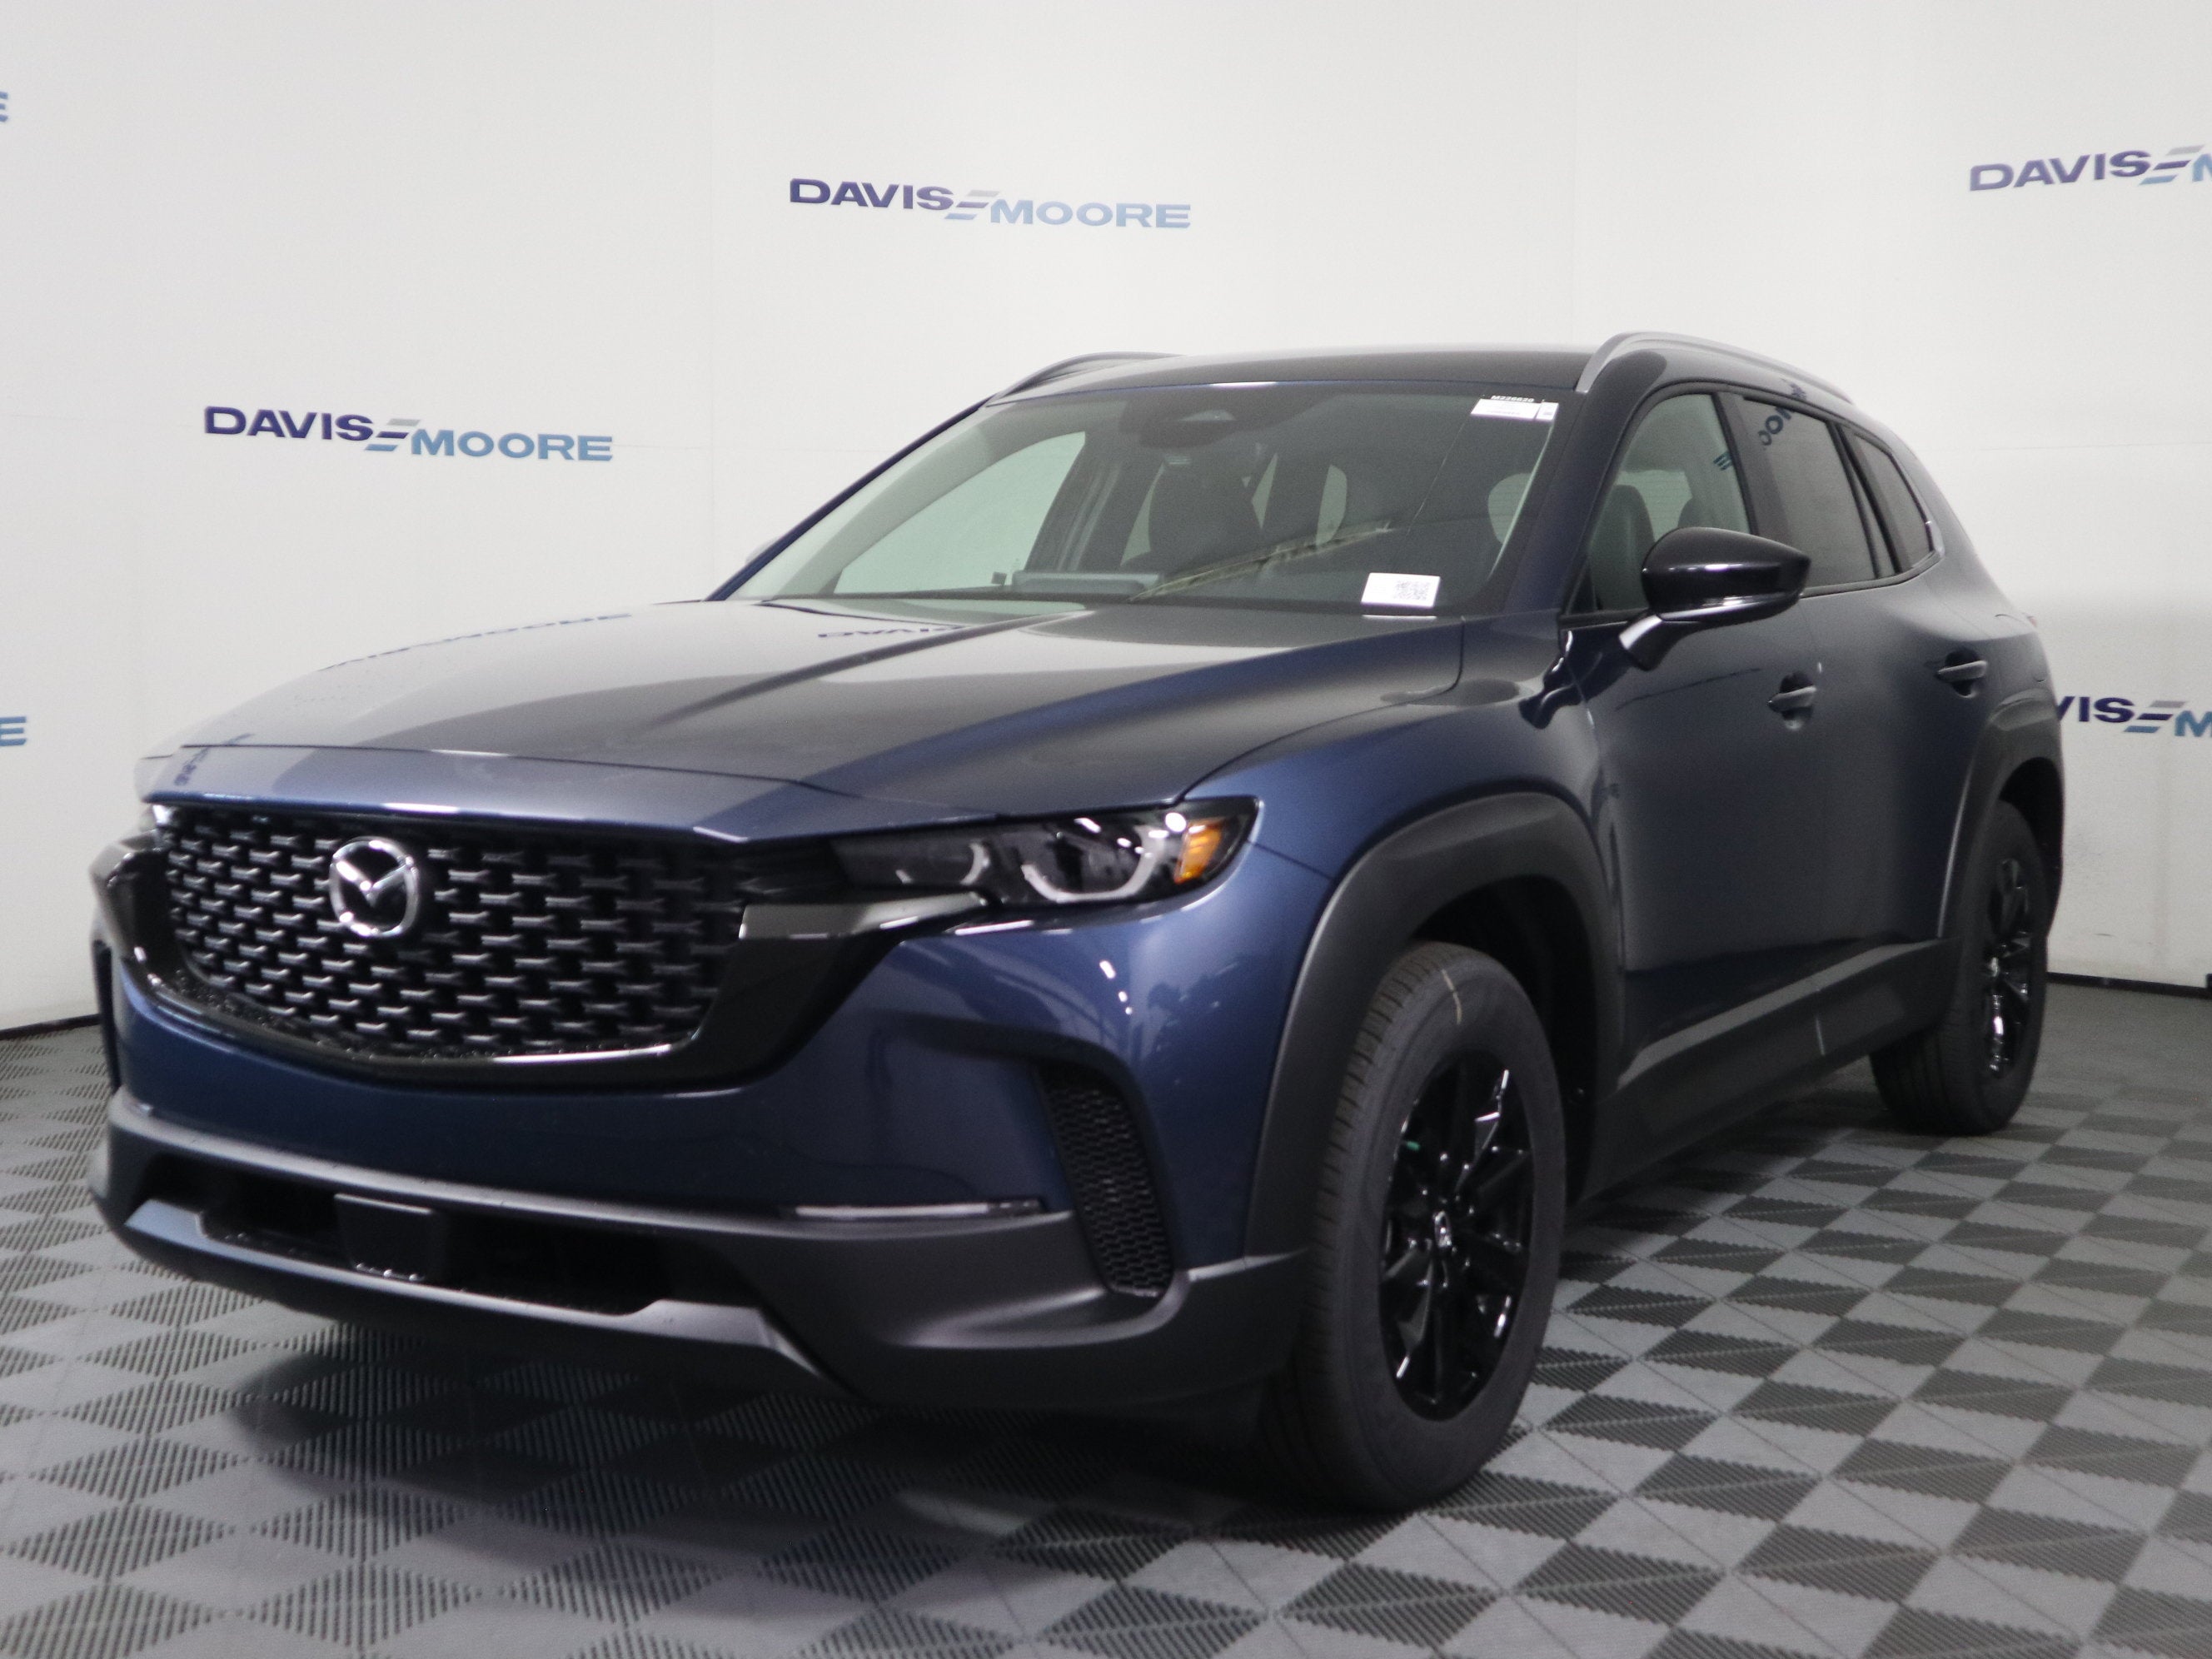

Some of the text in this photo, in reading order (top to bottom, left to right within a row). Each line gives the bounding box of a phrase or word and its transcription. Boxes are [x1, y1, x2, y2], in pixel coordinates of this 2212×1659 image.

[1969, 150, 2152, 192] DAVIS
[790, 177, 1191, 229] DAVIS MOORE
[203, 405, 614, 461] DAVIS MOORE
[2055, 695, 2135, 724] VIS
